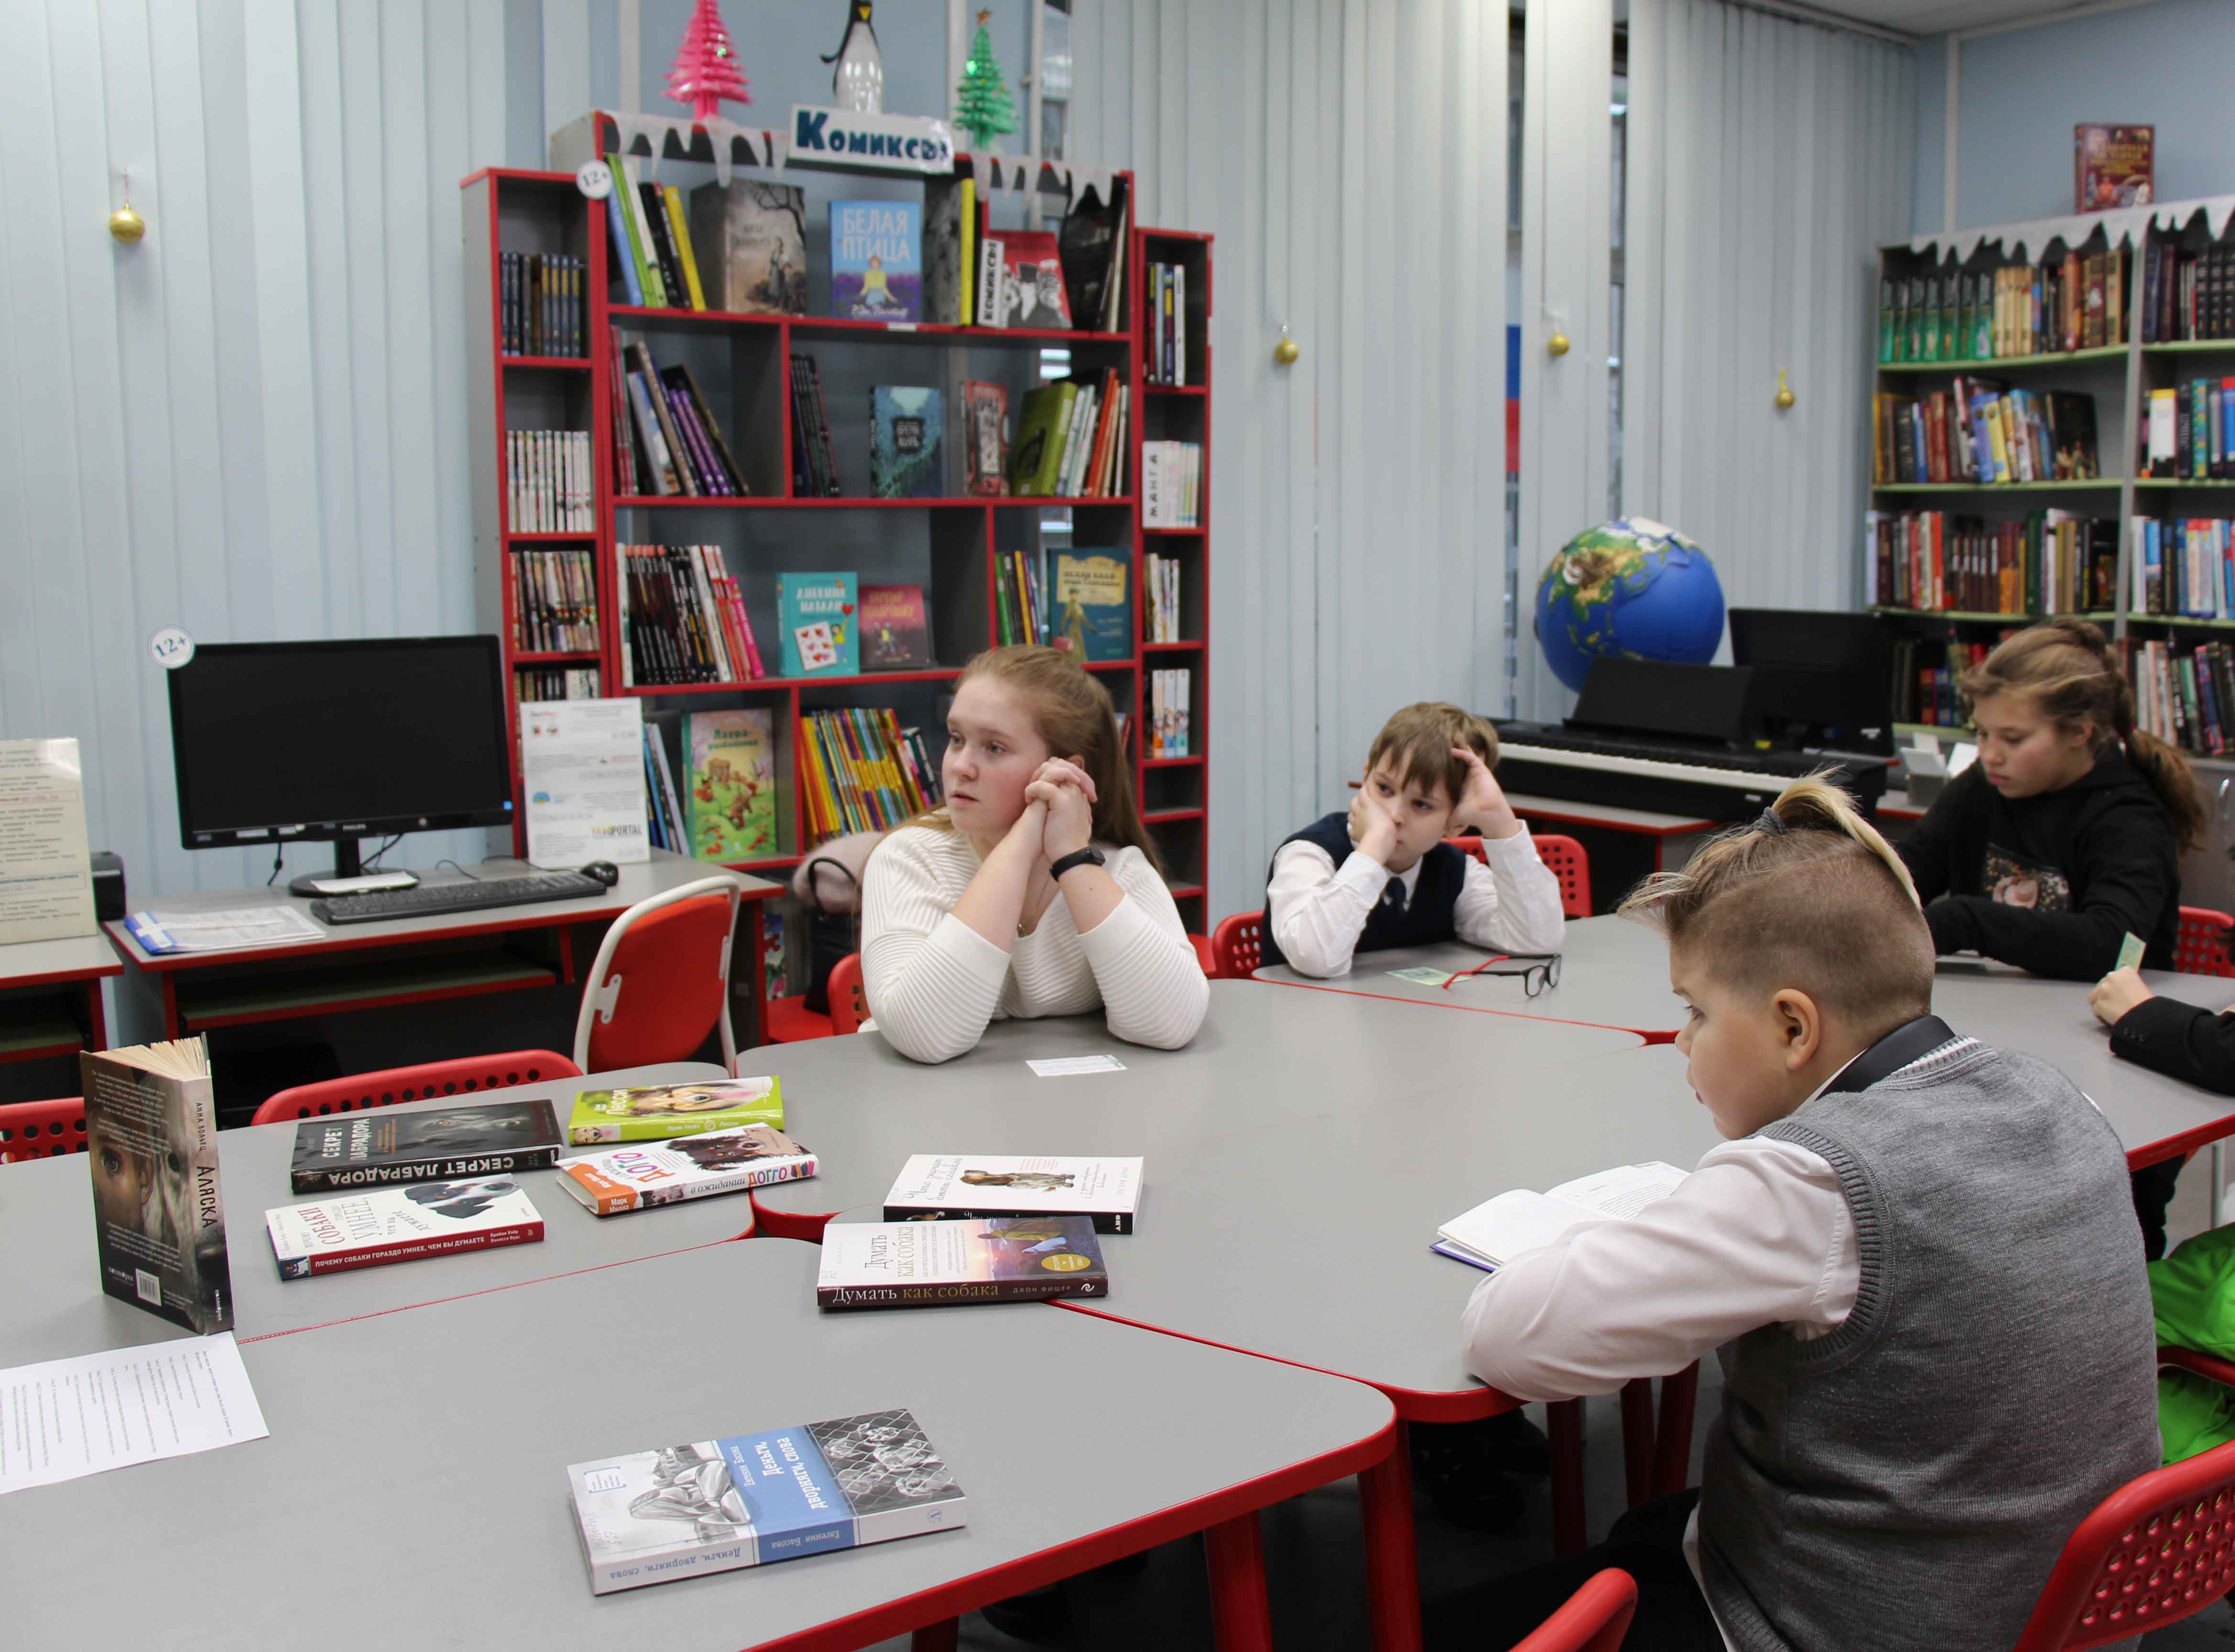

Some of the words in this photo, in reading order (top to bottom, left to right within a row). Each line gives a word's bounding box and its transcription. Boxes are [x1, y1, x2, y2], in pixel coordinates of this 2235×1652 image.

[796, 109, 948, 161] Комиксы
[154, 158, 185, 179] 12+
[582, 170, 608, 187] 12+
[842, 208, 908, 234] БЕЛАЯ
[842, 237, 910, 262] ПТИЦА
[985, 242, 996, 320] КОМИКСЫ
[1149, 454, 1158, 517] МАНГА
[195, 1101, 205, 1123] АННА
[322, 1127, 343, 1159] СЕКРЕТ
[350, 1118, 371, 1161] ЛАБРАДОРА
[328, 1165, 437, 1185] ЛАБРАДОРА
[445, 1157, 514, 1175] СЕКРЕТ
[612, 1152, 676, 1183] ДОГГО
[697, 1178, 745, 1194] ожидании
[748, 1167, 787, 1186] ДОГГО
[196, 1165, 218, 1229] АЛЯСКА
[297, 1207, 345, 1244] СОБАКИ
[341, 1197, 383, 1240] УМНЕЕ,
[315, 1256, 344, 1268] ПОЧЕМУ
[344, 1253, 371, 1264] СОБАКИ
[372, 1249, 402, 1260] ГОРАЗДО
[403, 1245, 427, 1255] УМНЕЕ,
[428, 1242, 443, 1251] ЧЕМ
[455, 1235, 485, 1247] ДУМАЕТЕ
[865, 1235, 888, 1270] Думать
[892, 1226, 914, 1260] собака
[897, 1260, 914, 1277] как
[833, 1286, 897, 1304] Думать
[903, 1287, 934, 1299] как
[938, 1282, 999, 1298] собака
[1040, 1285, 1071, 1293] ФИШЕР
[754, 1441, 785, 1477] Деньги,
[776, 1437, 800, 1462] слова
[771, 1535, 801, 1548] Басова
[805, 1530, 840, 1543] Евгения
[610, 1568, 639, 1579] слова
